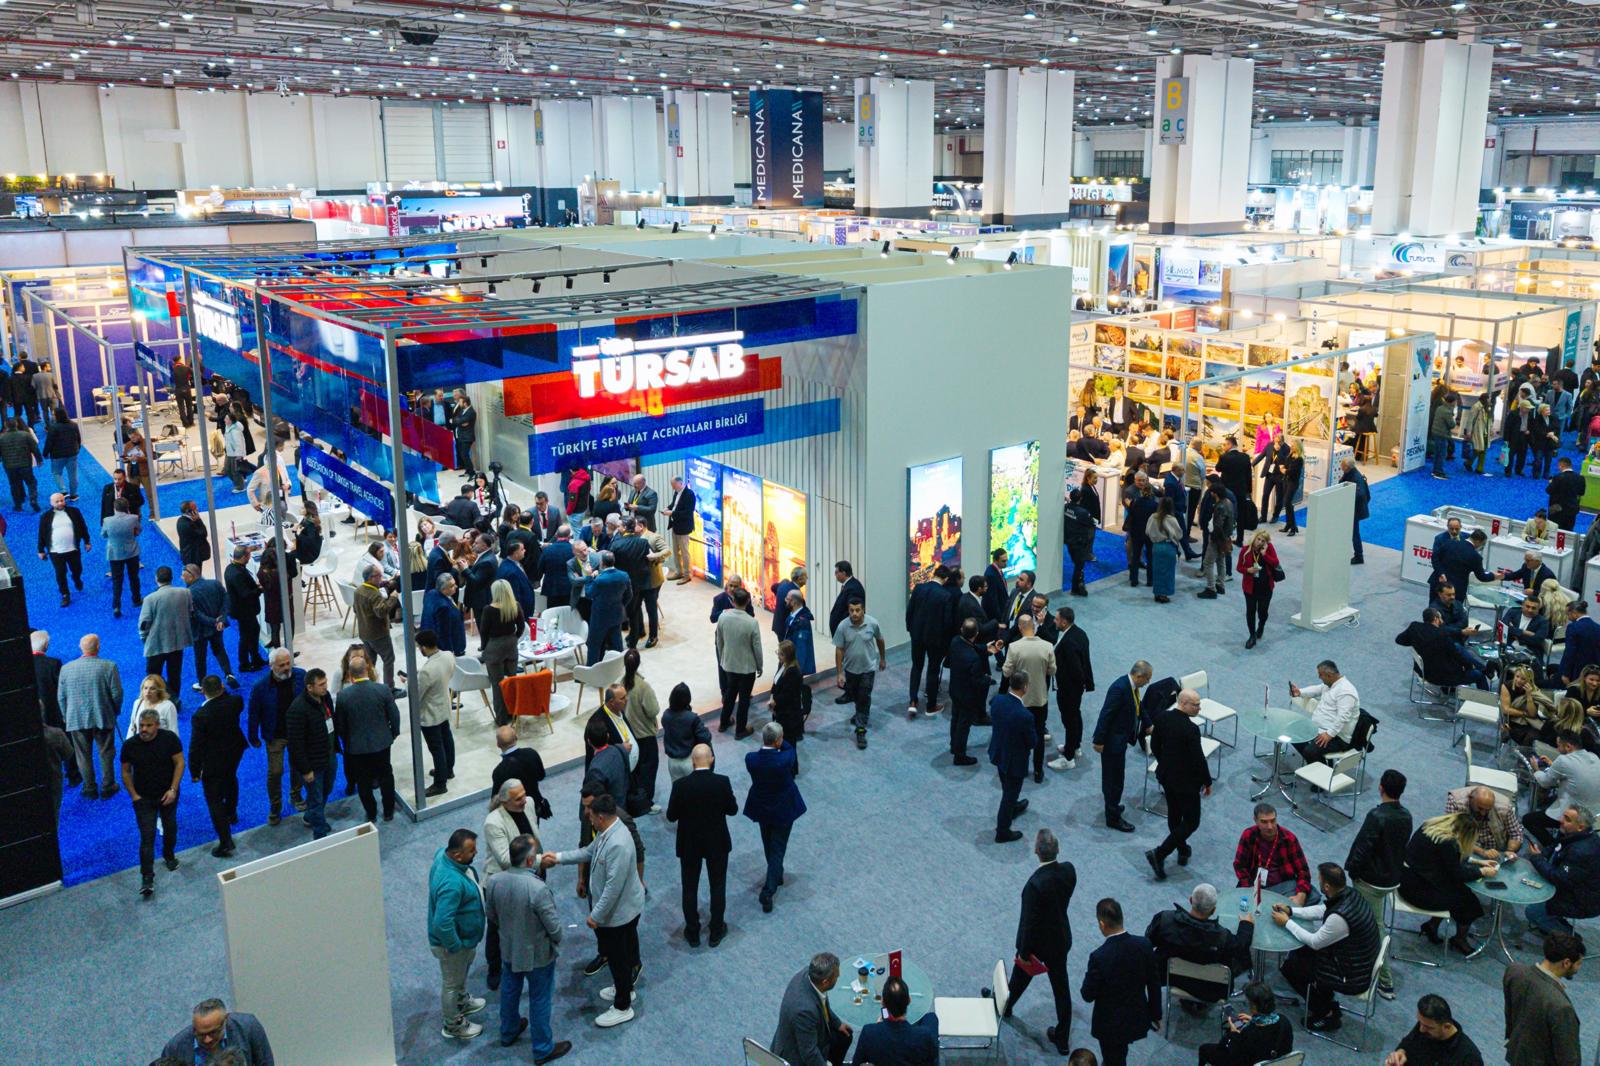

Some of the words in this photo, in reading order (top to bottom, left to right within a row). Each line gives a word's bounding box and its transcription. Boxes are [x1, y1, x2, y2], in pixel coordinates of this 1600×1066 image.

[861, 95, 871, 120] B
[1167, 81, 1182, 109] B
[859, 126, 865, 137] a
[1162, 118, 1170, 132] a
[1176, 118, 1184, 131] c
[755, 108, 766, 201] MEDICANA
[791, 110, 804, 199] MEDICANA
[572, 343, 746, 398] TÜRSAB
[551, 439, 598, 457] TÜRKİYE
[601, 431, 648, 448] SEYAHAT
[652, 420, 713, 440] ACENTALARI
[715, 412, 748, 428] BİRLİĞİ
